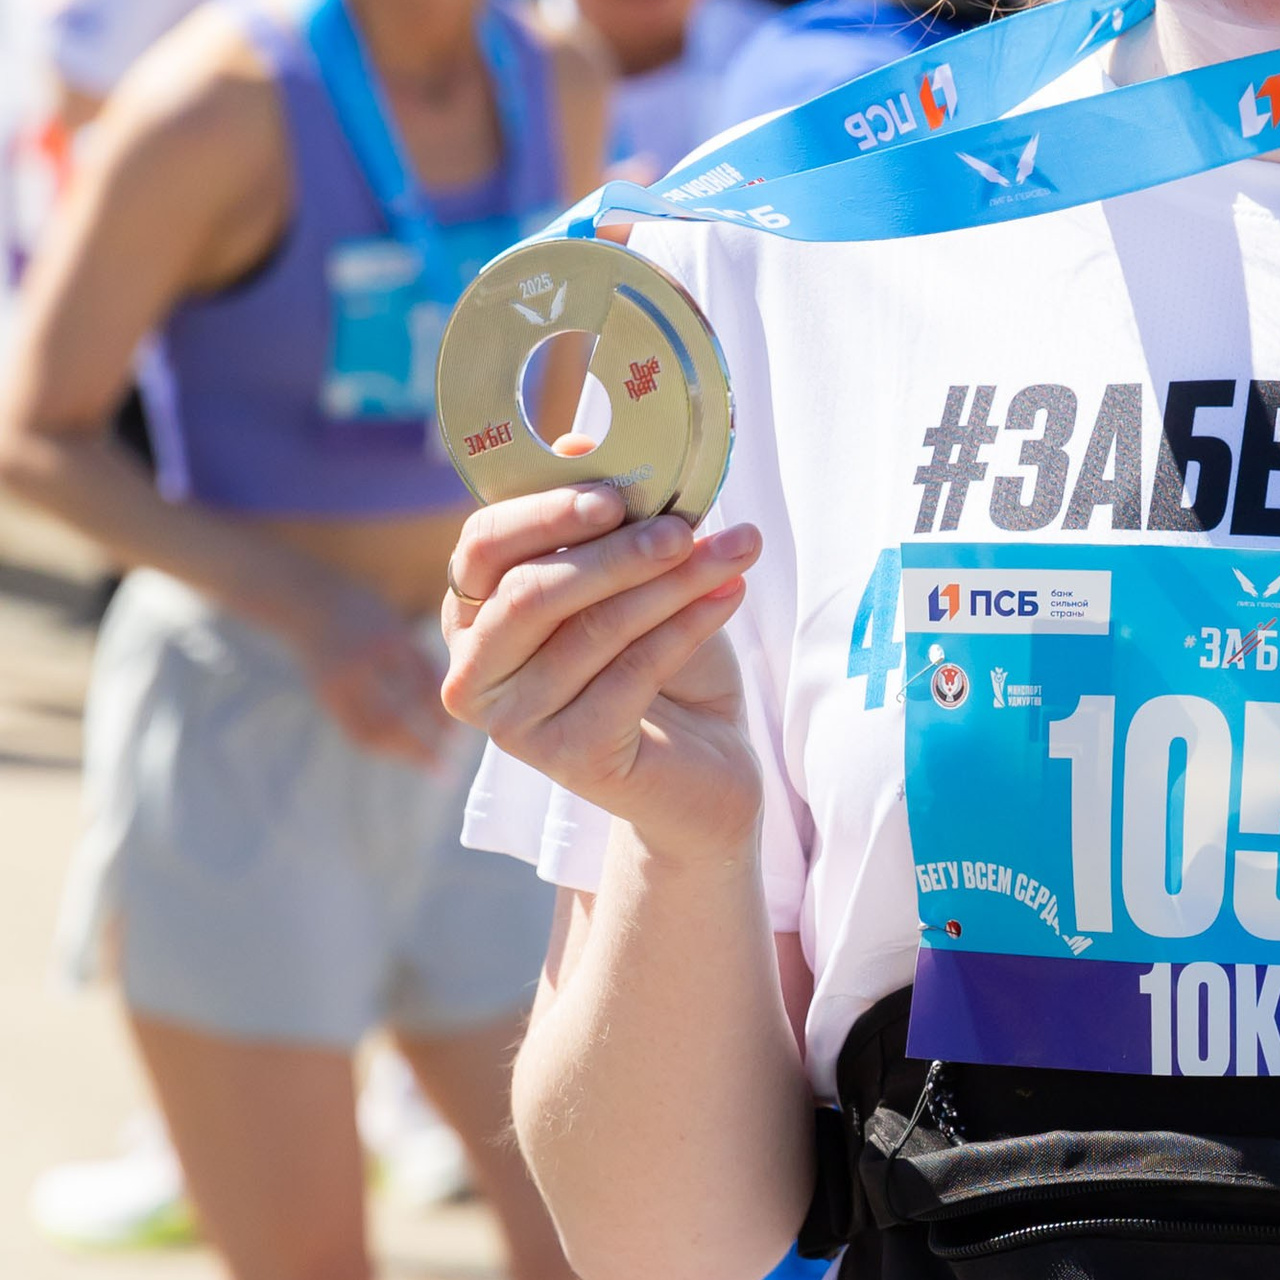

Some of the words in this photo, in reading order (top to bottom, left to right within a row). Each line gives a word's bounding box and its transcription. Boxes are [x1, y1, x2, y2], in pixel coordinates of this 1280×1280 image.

[519, 273, 553, 298] 2025
[464, 421, 513, 457] ЗАБЕГ
[970, 590, 1039, 617] ПСБ
[1050, 598, 1089, 609] сильной
[1051, 588, 1074, 598] банк
[1050, 609, 1085, 618] страны
[916, 861, 958, 893] БЕГУ
[962, 861, 1012, 895] ВСЕМ
